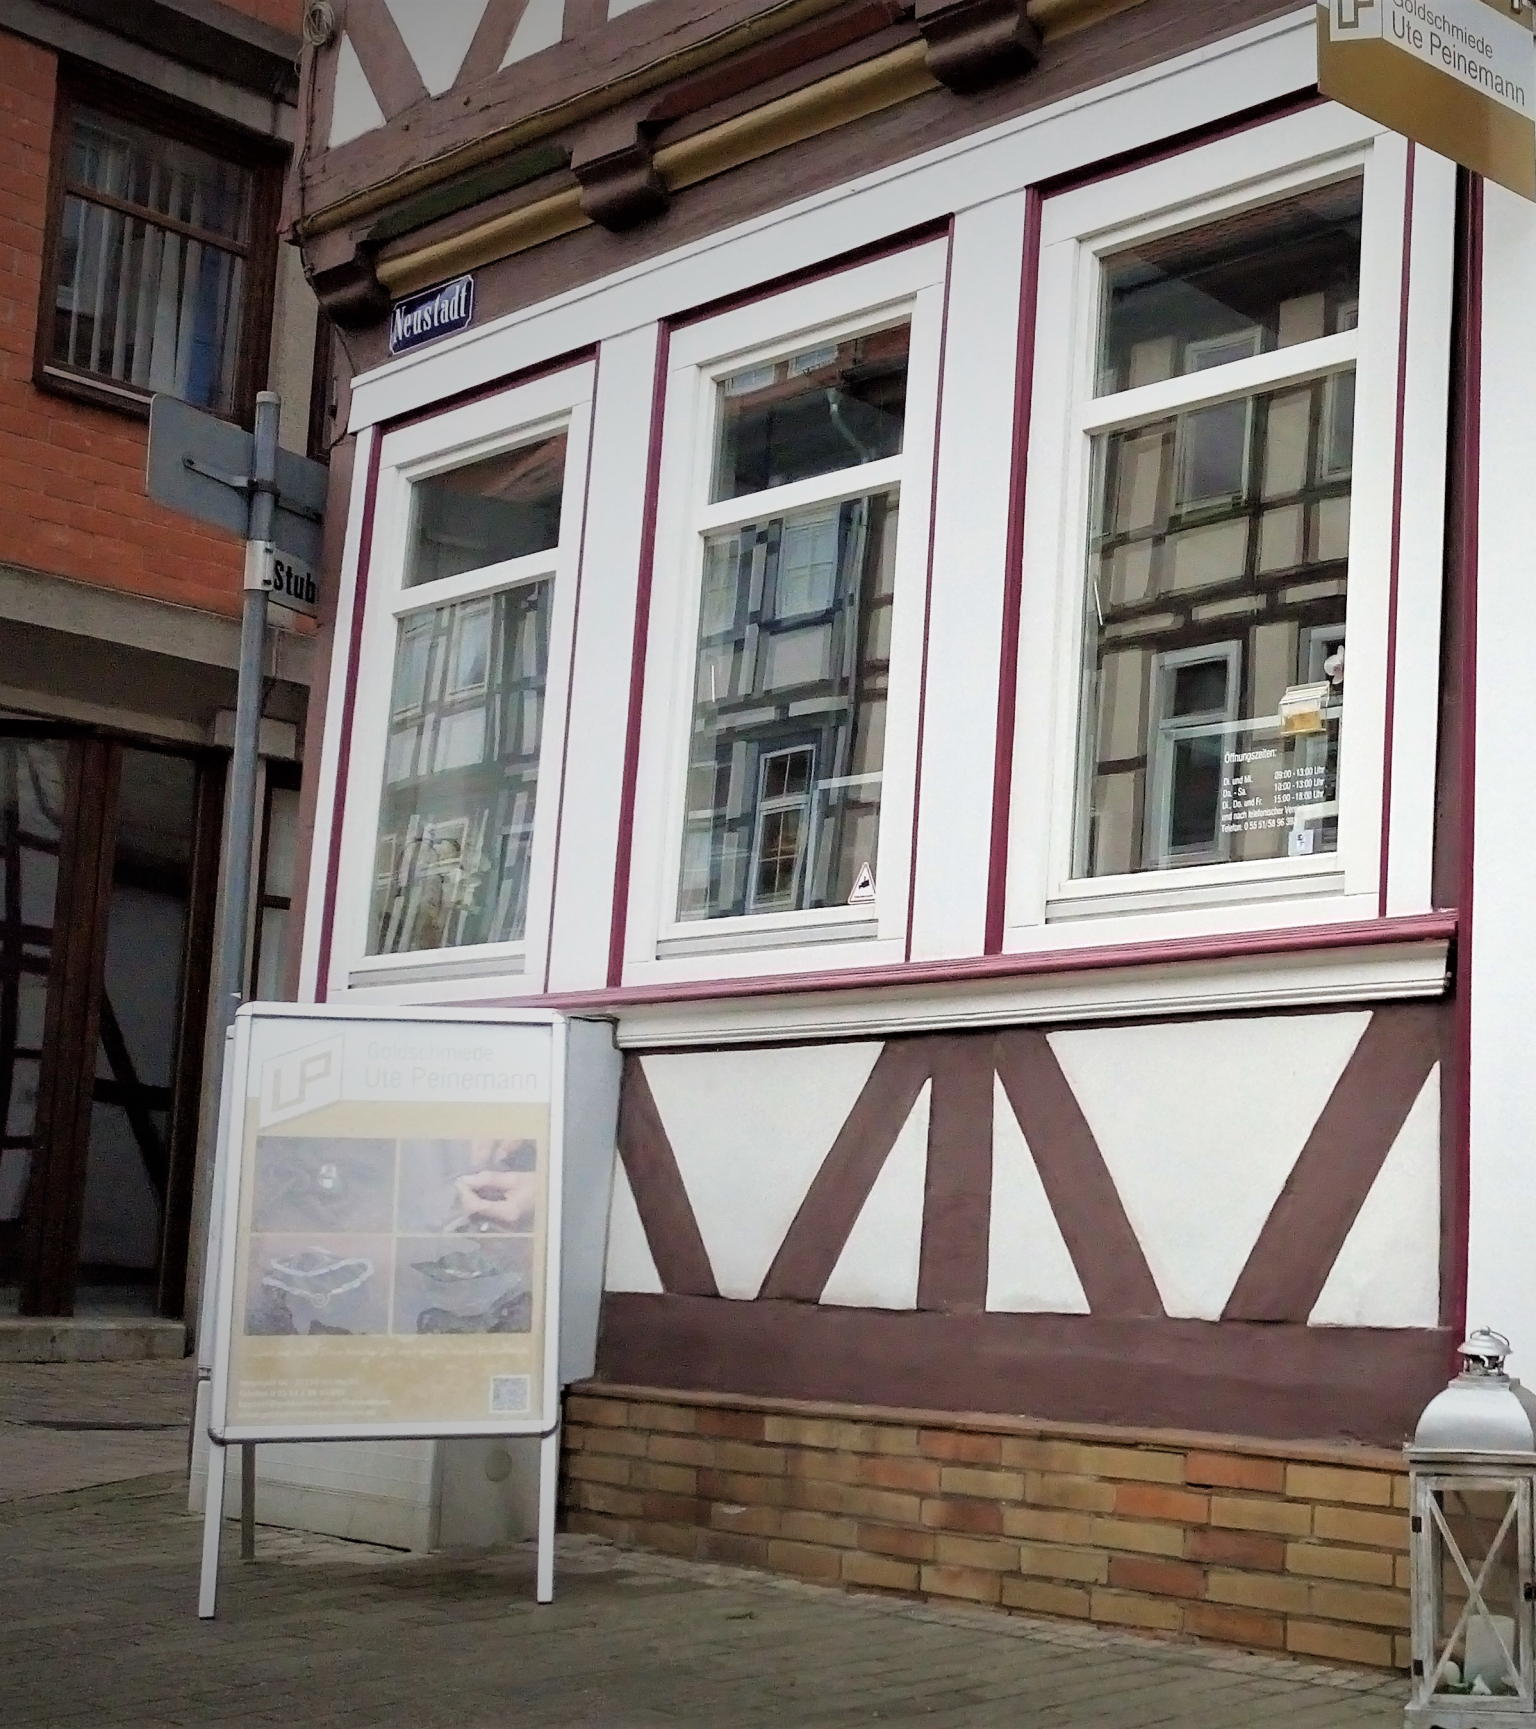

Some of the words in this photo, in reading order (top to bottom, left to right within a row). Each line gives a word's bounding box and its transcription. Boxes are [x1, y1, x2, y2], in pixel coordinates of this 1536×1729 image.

[1392, 10, 1423, 49] Ute
[1430, 31, 1525, 106] Peinemann
[394, 281, 467, 343] Neustadt
[274, 559, 316, 604] Stub
[366, 1040, 494, 1062] Goldschmiede
[364, 1066, 403, 1090] Ute
[411, 1066, 538, 1091] Peinemann
